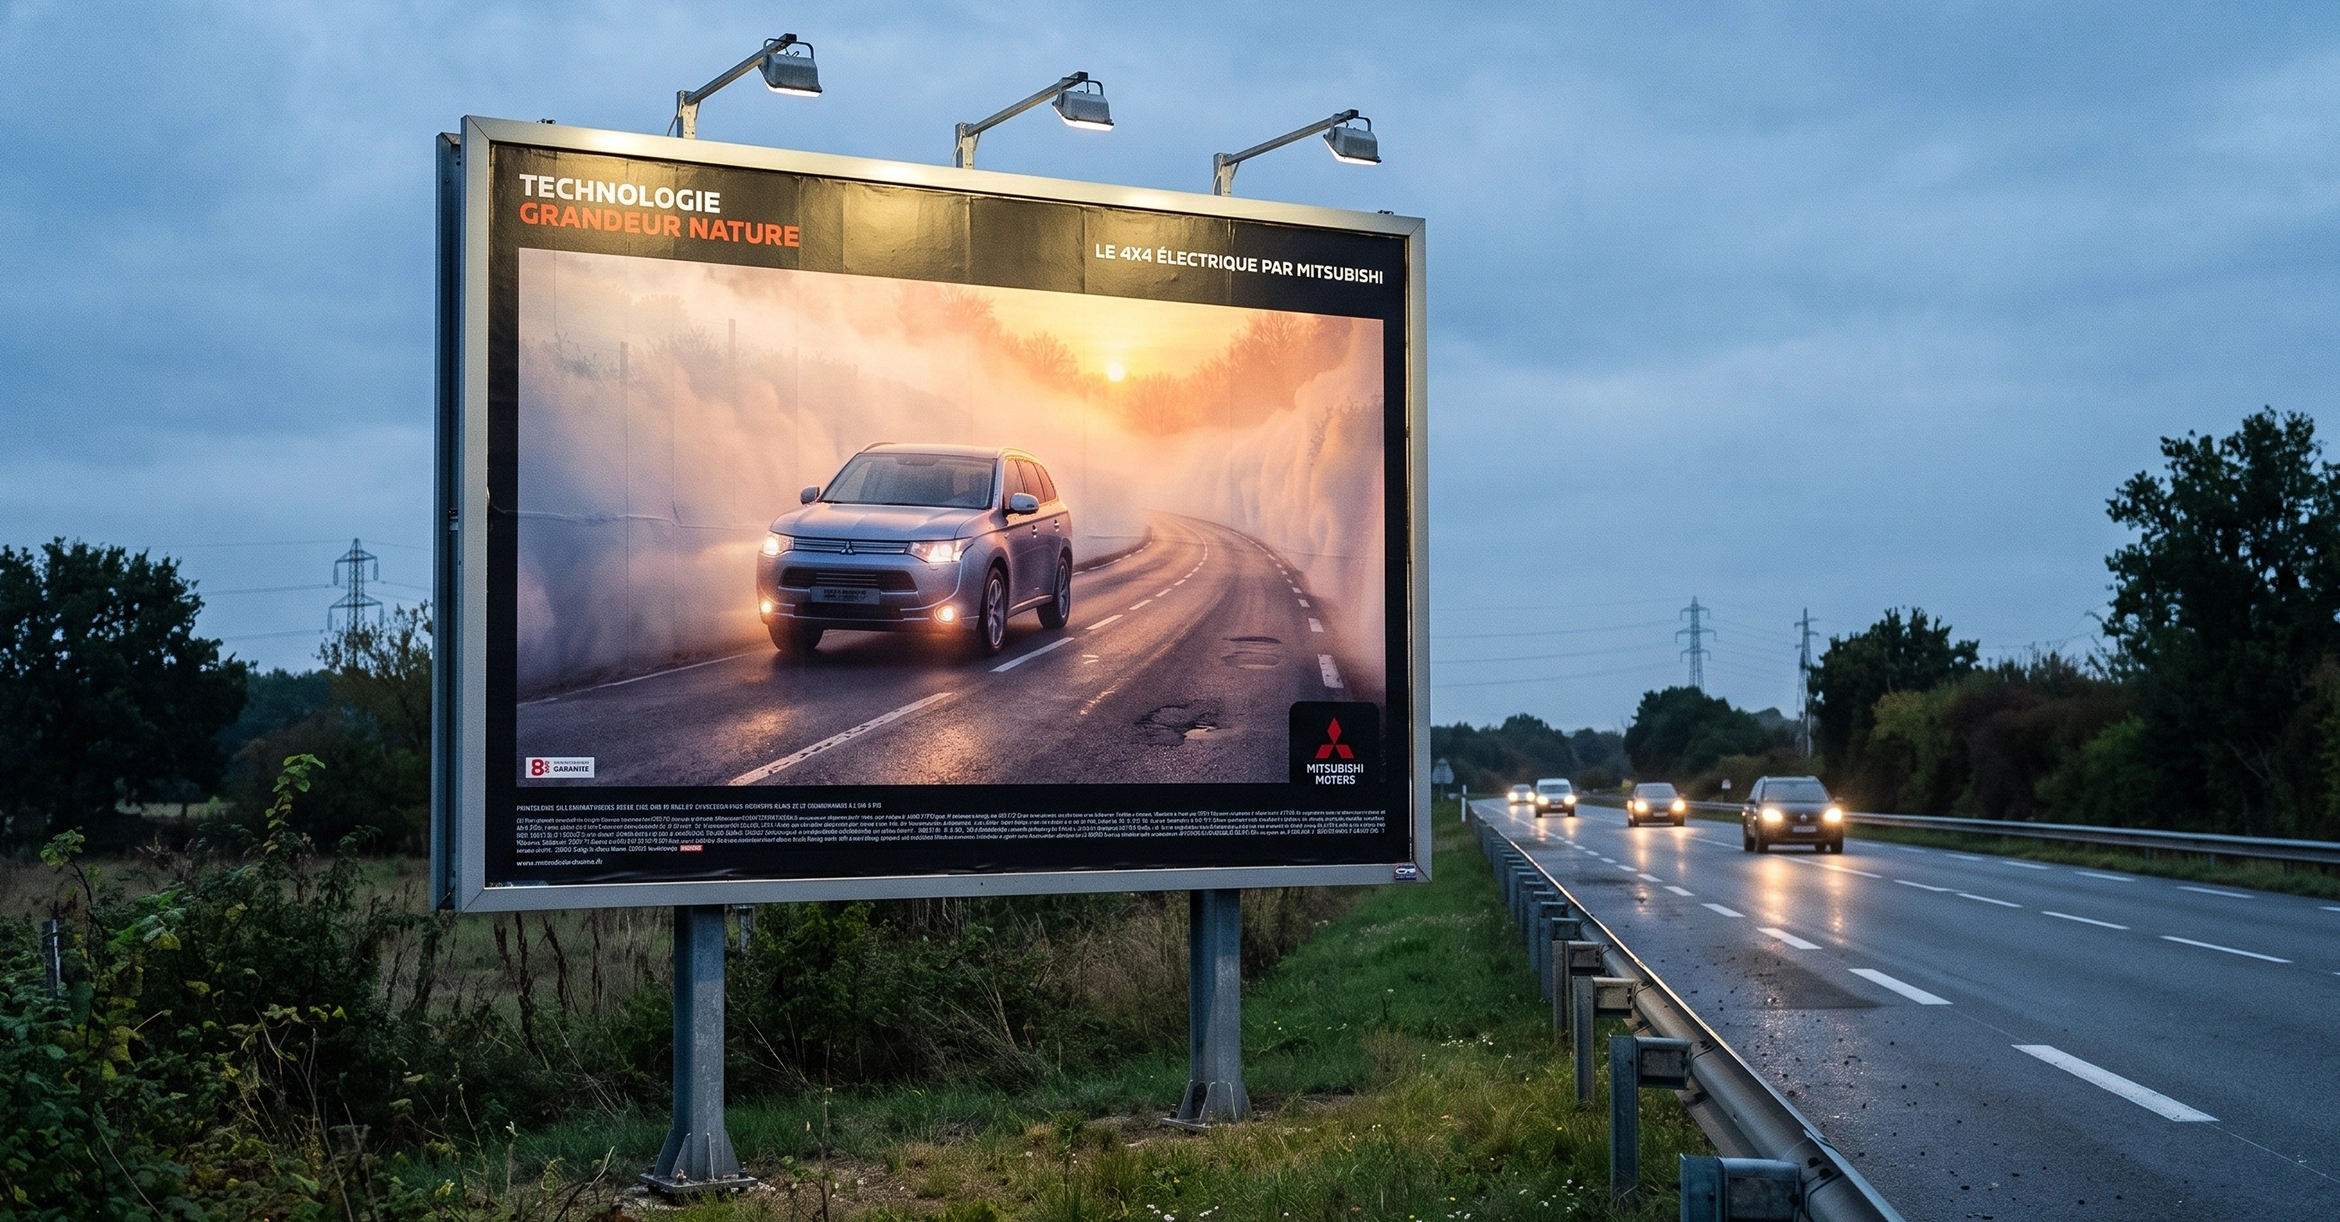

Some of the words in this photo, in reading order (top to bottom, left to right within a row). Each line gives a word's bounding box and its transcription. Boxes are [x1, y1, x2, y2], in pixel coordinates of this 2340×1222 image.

[519, 173, 721, 214] TECHNOLOGIE
[519, 203, 681, 237] GRANDEUR
[688, 216, 799, 247] NATURE
[1095, 243, 1116, 260] LE
[1120, 246, 1153, 263] 4X4
[1157, 246, 1258, 272] ÉLECTRIQUE
[1262, 259, 1293, 276] PAR
[1297, 263, 1383, 285] MITSUBISHI
[531, 758, 544, 776] 8
[1306, 763, 1364, 774] MITSUBISHI
[1315, 775, 1356, 785] MOTERS
